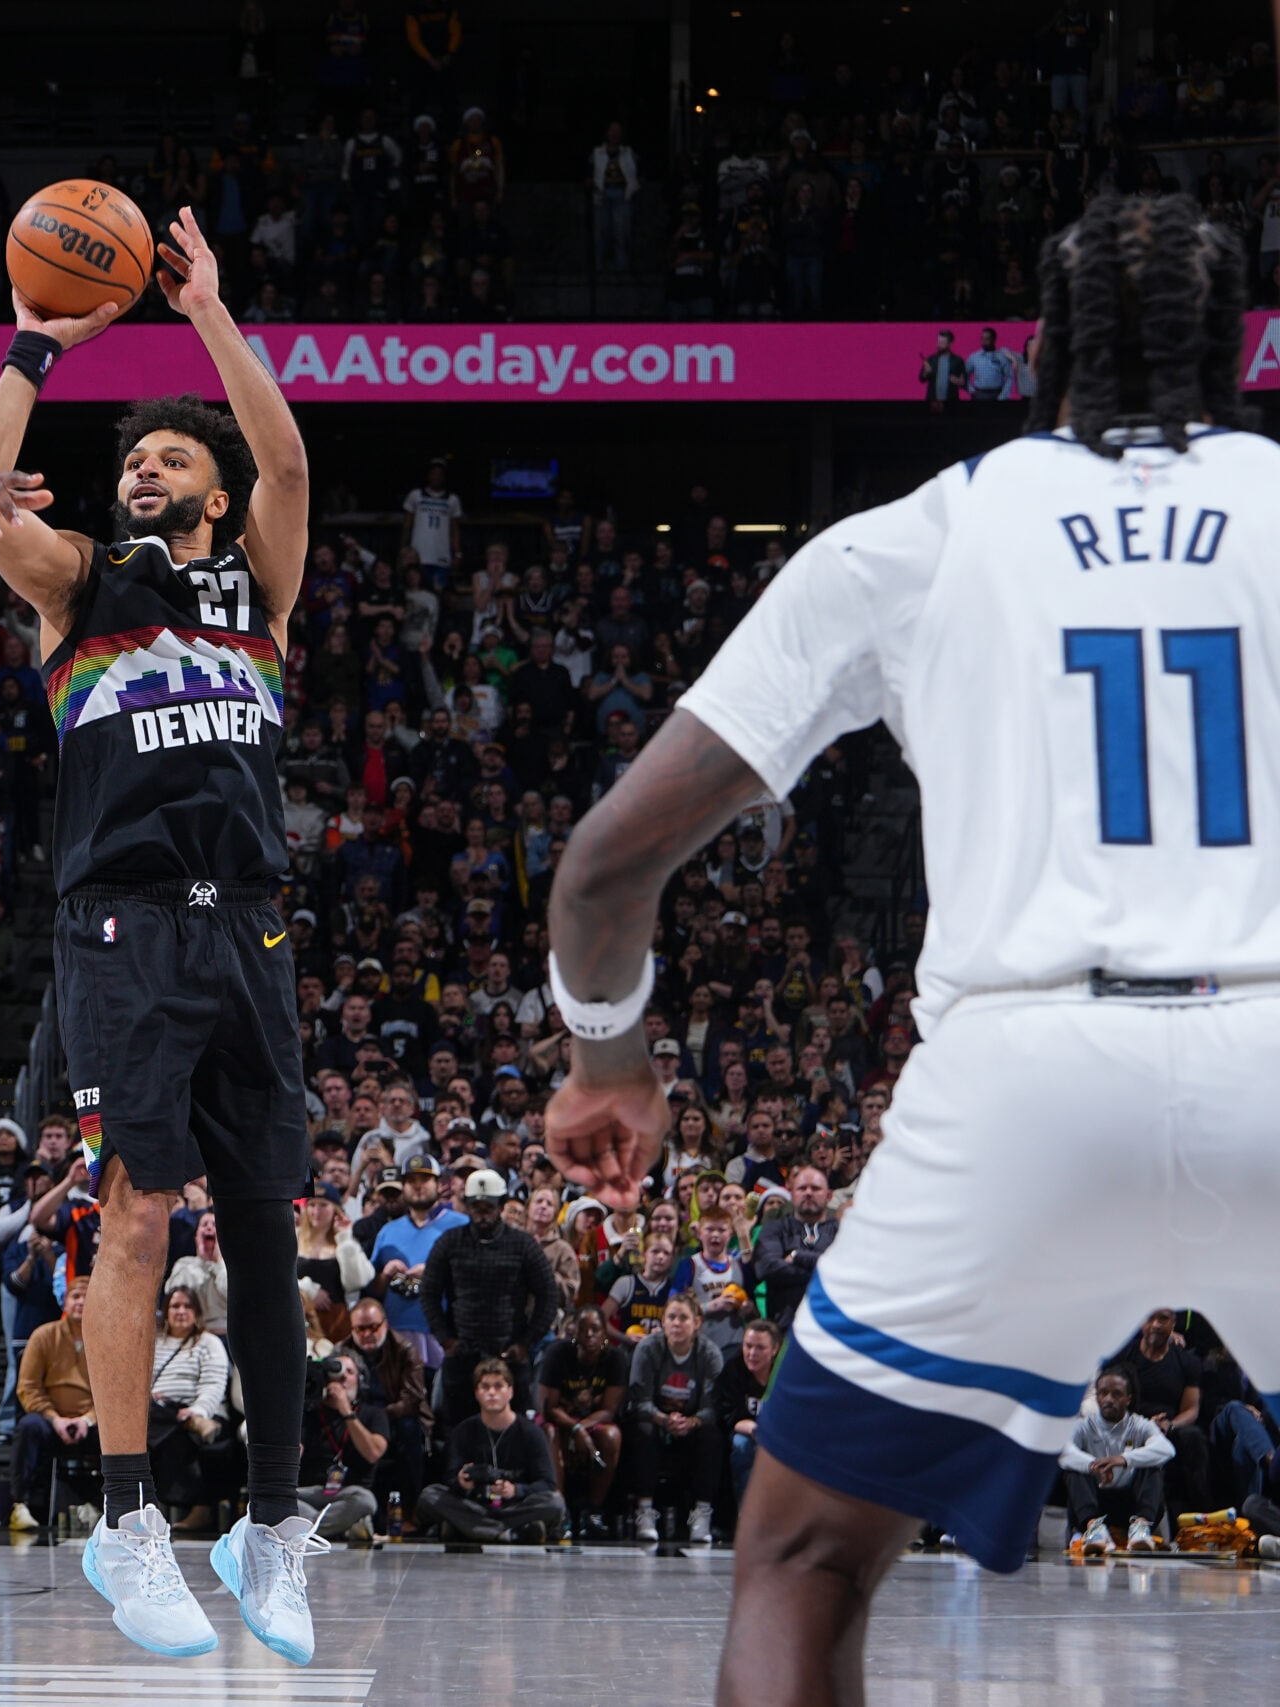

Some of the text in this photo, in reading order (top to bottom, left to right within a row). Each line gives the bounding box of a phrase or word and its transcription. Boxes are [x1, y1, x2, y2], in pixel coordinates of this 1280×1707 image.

[28, 211, 116, 274] Wilson
[1057, 505, 1230, 571] REID
[188, 570, 250, 632] 27
[131, 700, 262, 754] DENVER
[1060, 626, 1252, 848] 11
